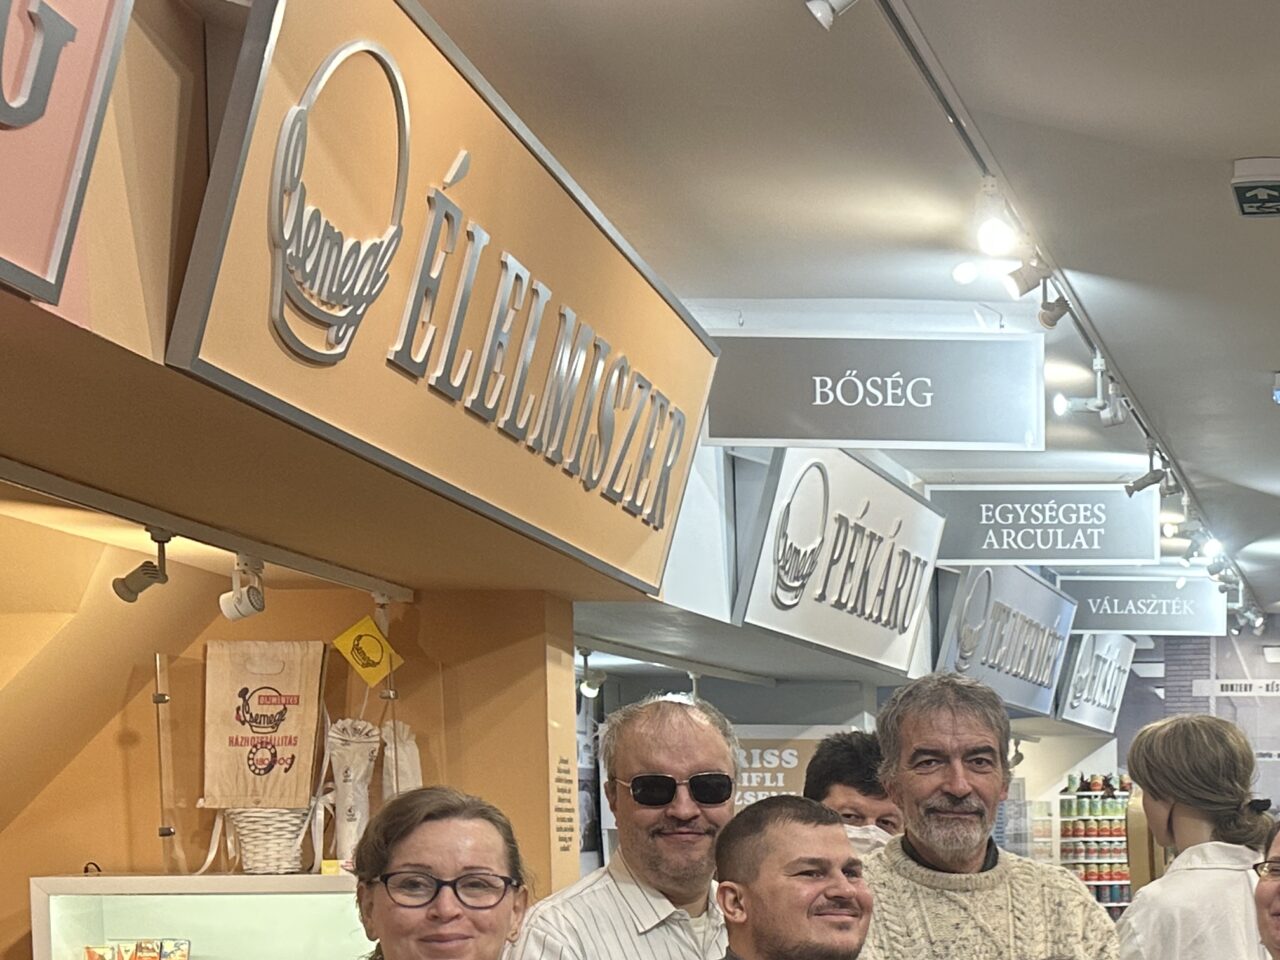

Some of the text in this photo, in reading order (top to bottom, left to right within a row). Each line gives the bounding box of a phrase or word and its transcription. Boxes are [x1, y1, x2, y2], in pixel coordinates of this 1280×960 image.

[387, 149, 687, 531] ÉLELMISZER
[812, 371, 934, 409] BŐSÉG
[979, 500, 1107, 525] EGYSÉGES
[981, 527, 1105, 550] ARCULAT
[813, 499, 929, 636] PÉKÁRU
[1087, 596, 1195, 616] VÁLASZTÉK
[736, 748, 799, 768] RISS
[738, 772, 785, 787] IFLI
